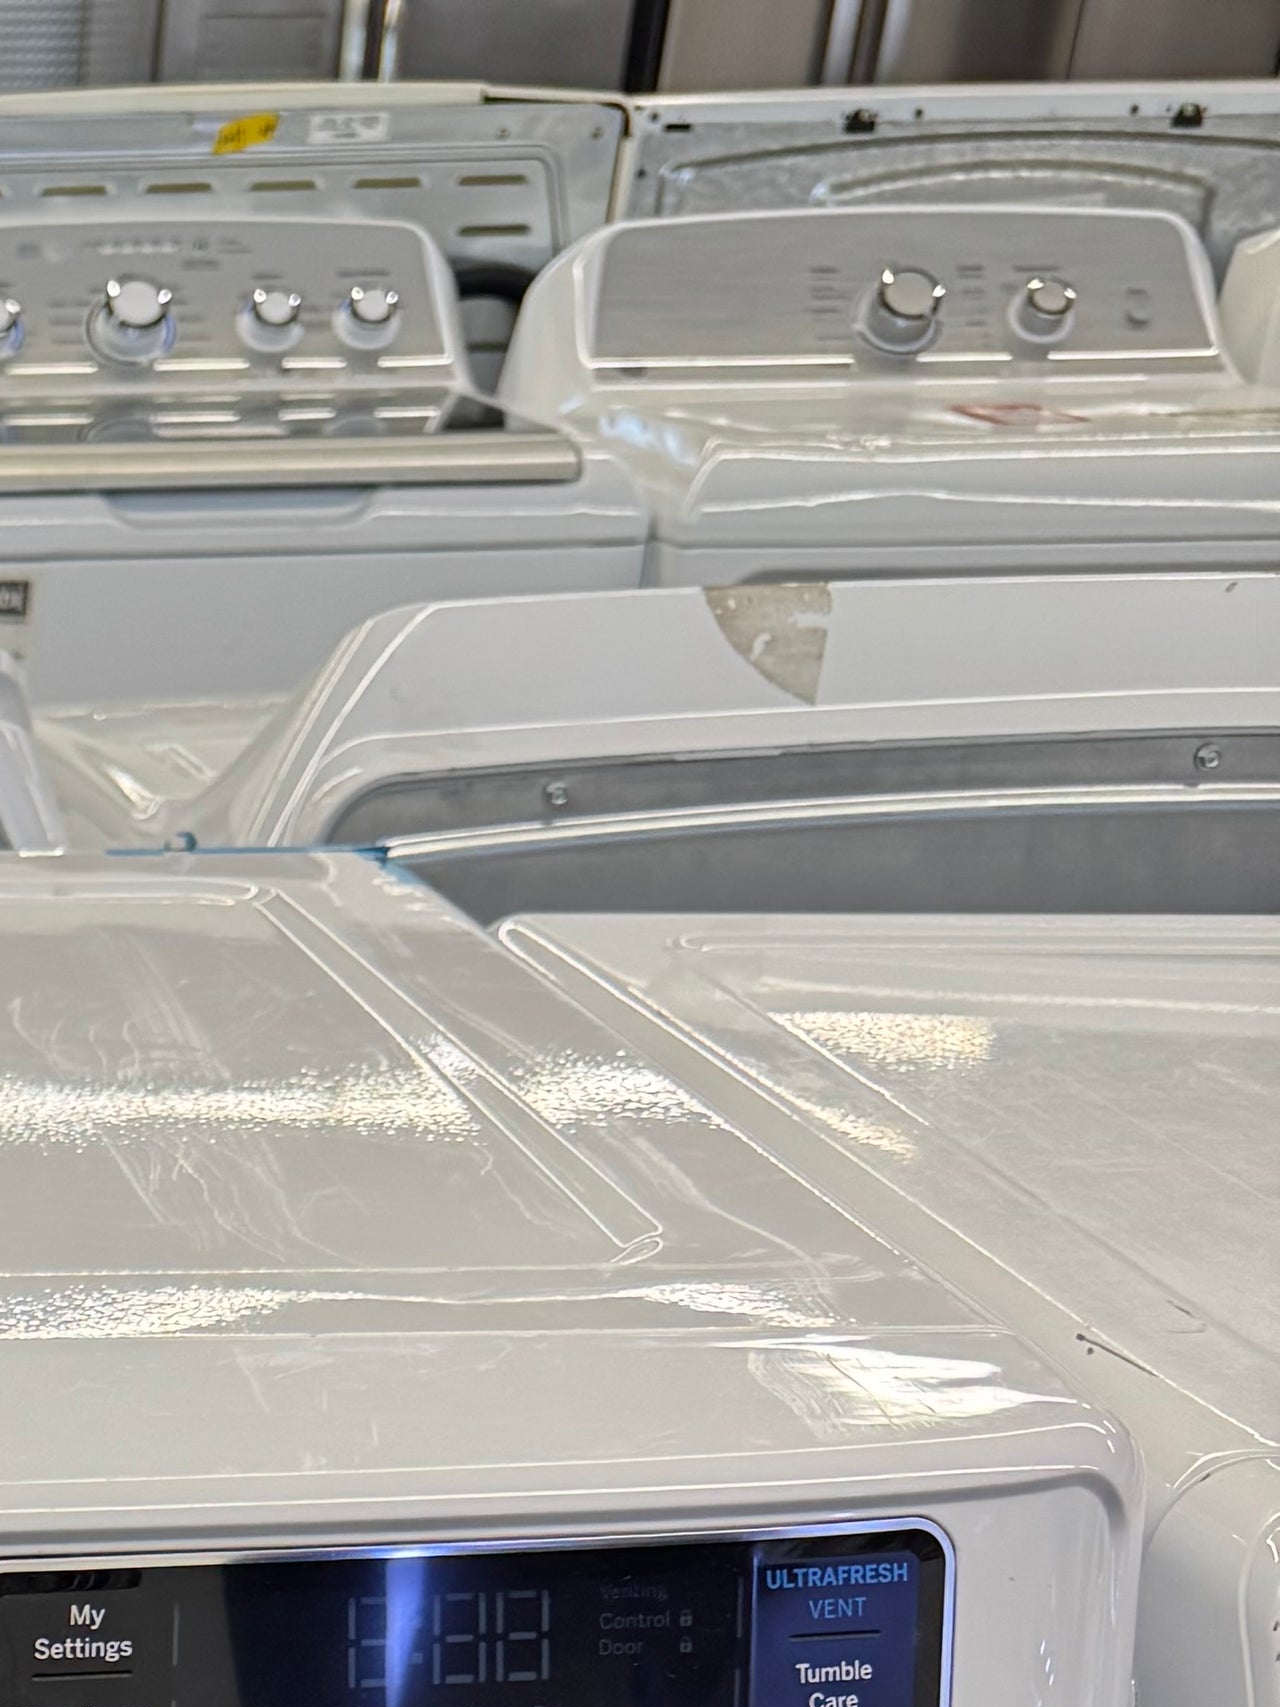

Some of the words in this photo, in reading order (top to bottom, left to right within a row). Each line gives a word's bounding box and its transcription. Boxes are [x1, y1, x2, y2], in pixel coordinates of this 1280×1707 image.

[766, 1562, 908, 1590] ULTRAFRESH
[71, 1605, 105, 1629] My
[600, 1609, 670, 1629] Control
[809, 1597, 866, 1618] VENT
[35, 1638, 132, 1661] Settings
[600, 1639, 643, 1655] Door
[796, 1660, 872, 1683] Tumble
